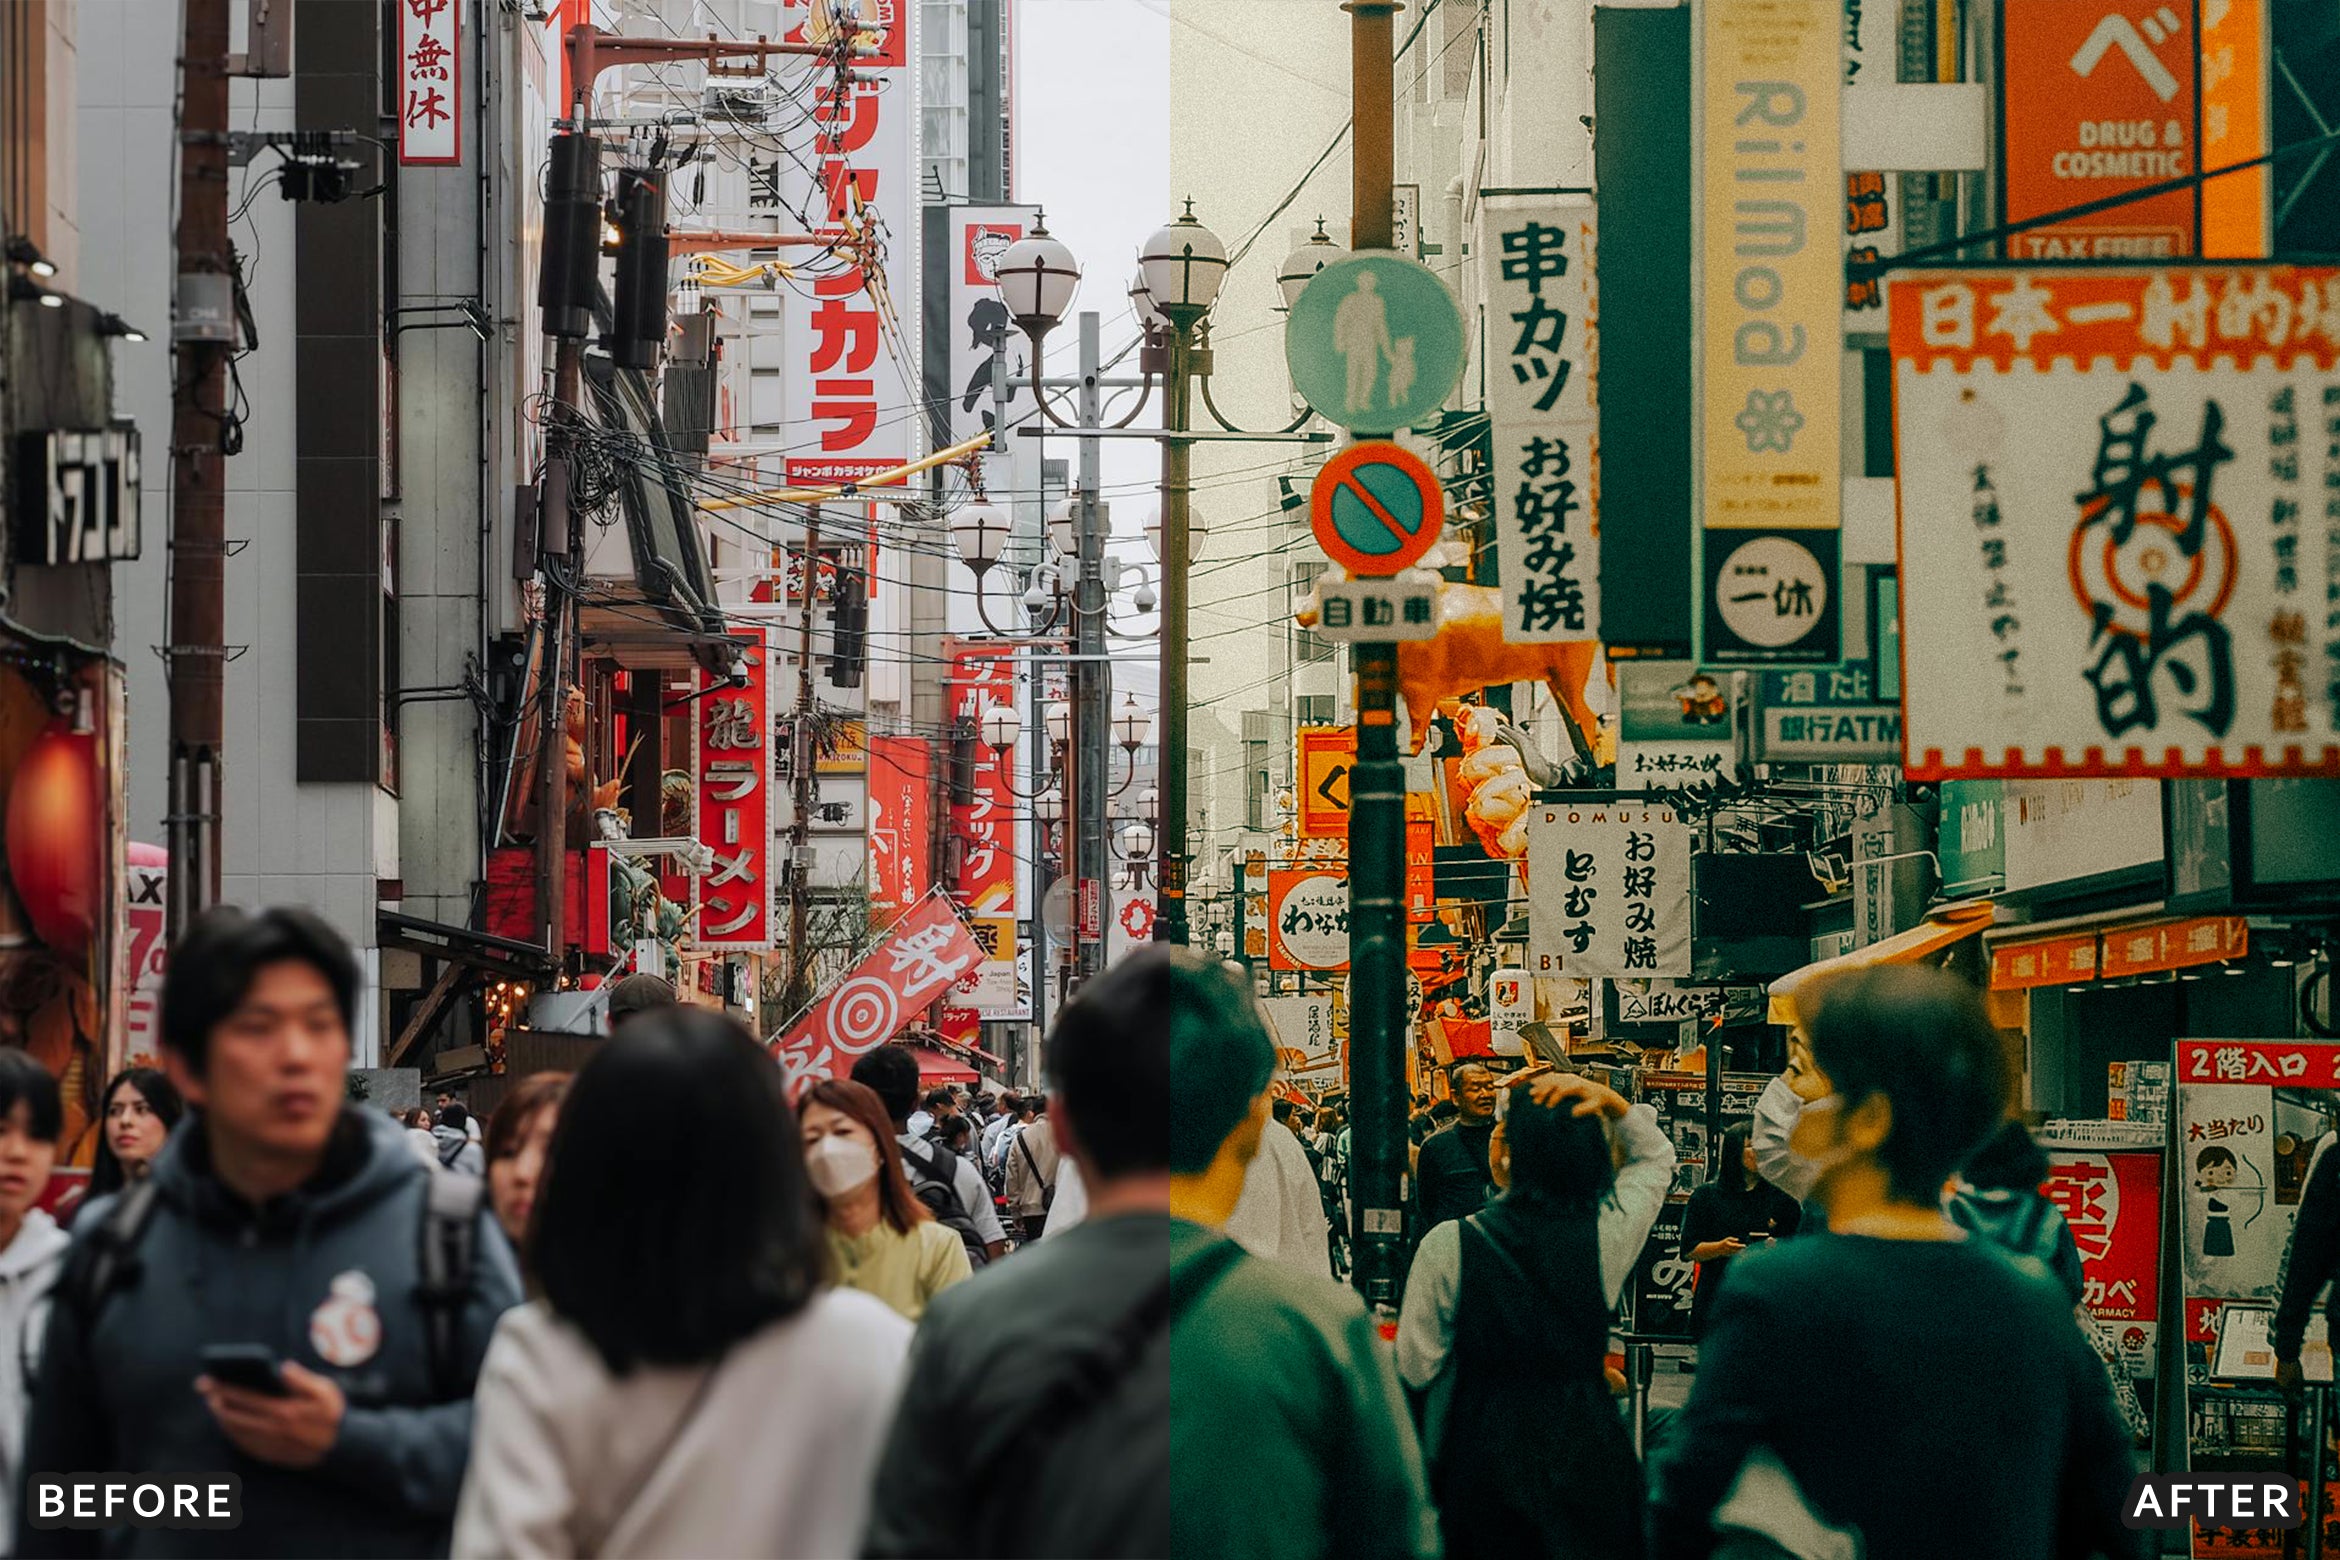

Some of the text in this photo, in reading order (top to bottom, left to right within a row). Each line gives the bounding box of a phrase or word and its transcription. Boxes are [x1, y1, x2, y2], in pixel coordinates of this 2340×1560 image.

[2070, 6, 2182, 103] ベ
[2079, 120, 2157, 148] DRUG
[2052, 151, 2183, 179] COSMETIC
[1500, 221, 1586, 632] 串カツ お好み焼
[2074, 382, 2236, 738] 射的
[1323, 597, 1432, 627] 自動車
[1730, 576, 1813, 617] 一休
[704, 645, 761, 936] 龍ラーメン
[1545, 812, 1673, 824] DOMUSU
[1563, 849, 1596, 954] どむす
[1622, 830, 1657, 970] お好み焼
[1539, 954, 1565, 971] B1
[2191, 1046, 2308, 1080] 2階入口
[2187, 1114, 2266, 1143] 大当たり
[2086, 1307, 2136, 1318] ARMACY
